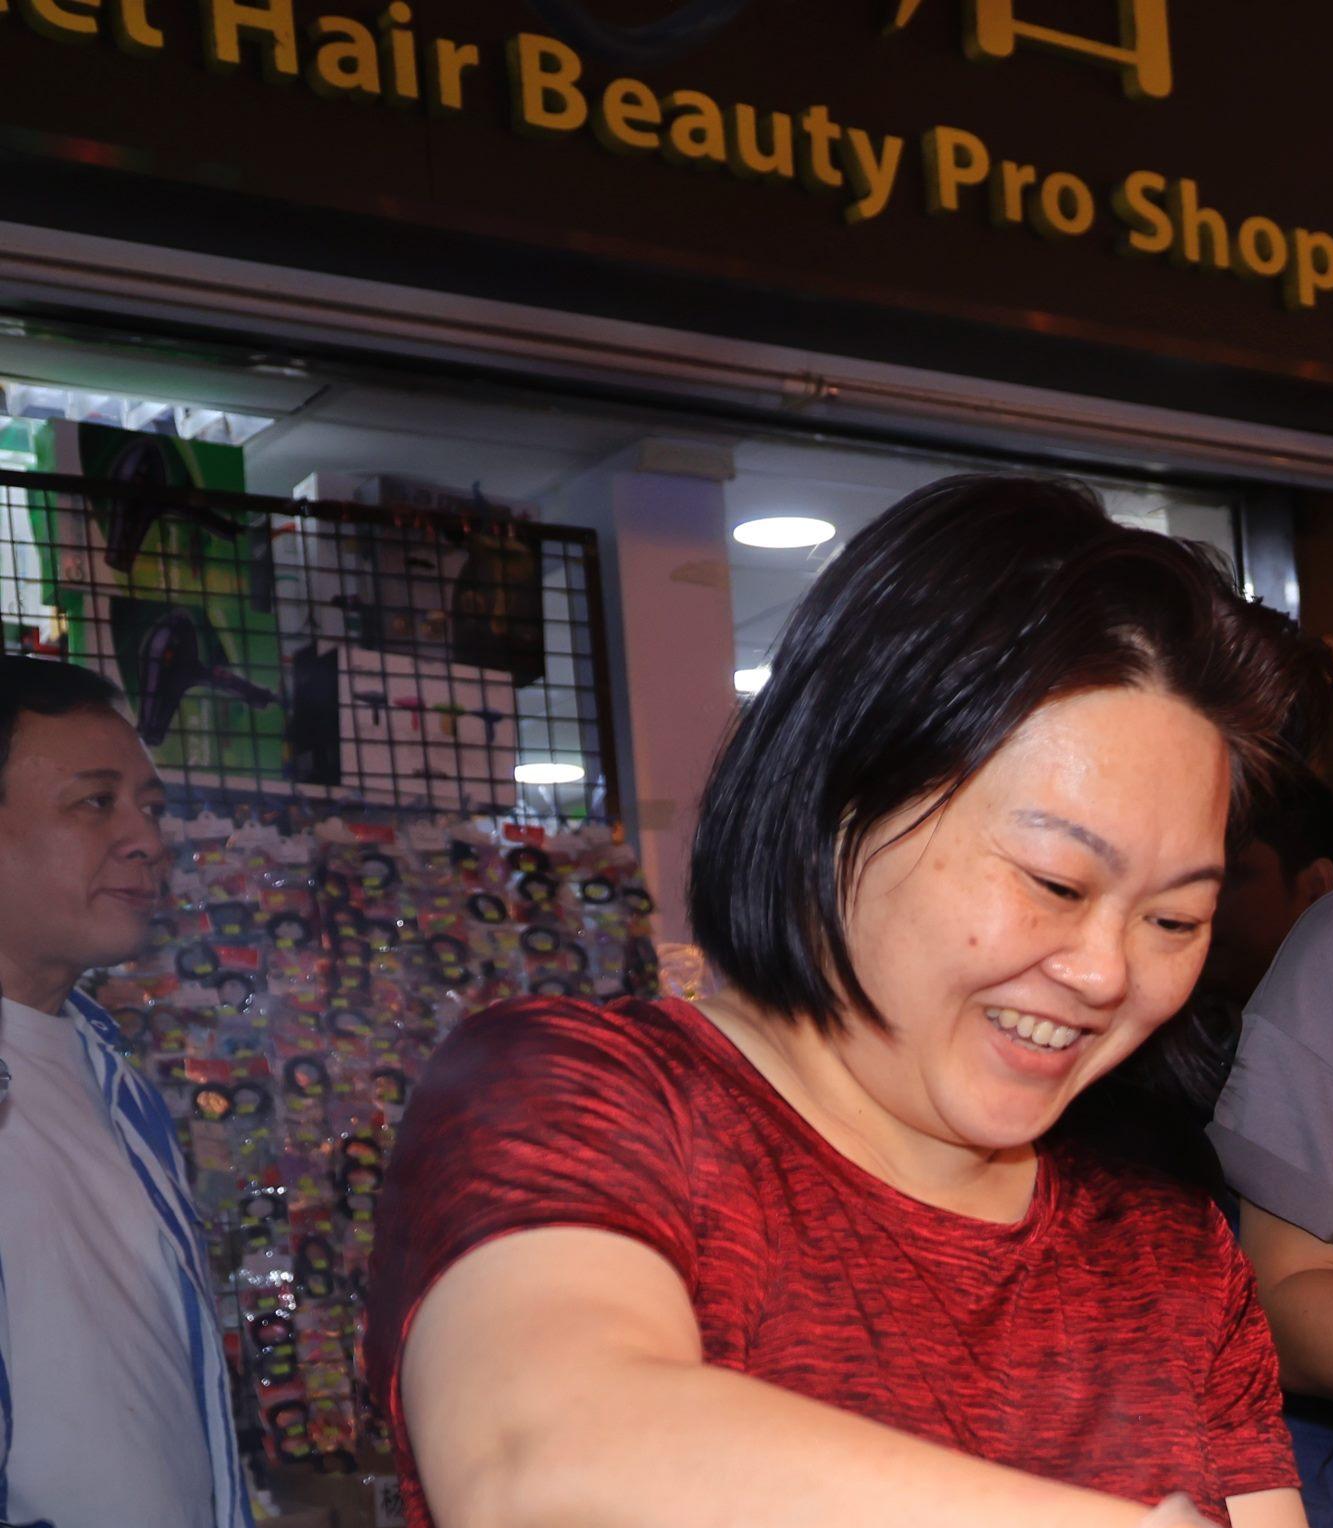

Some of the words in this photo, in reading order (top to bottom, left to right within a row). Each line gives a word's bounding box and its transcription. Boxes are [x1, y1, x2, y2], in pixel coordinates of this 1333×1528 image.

[209, 0, 479, 111] Hair
[511, 33, 904, 223] Beauty
[925, 124, 1095, 236] Pro
